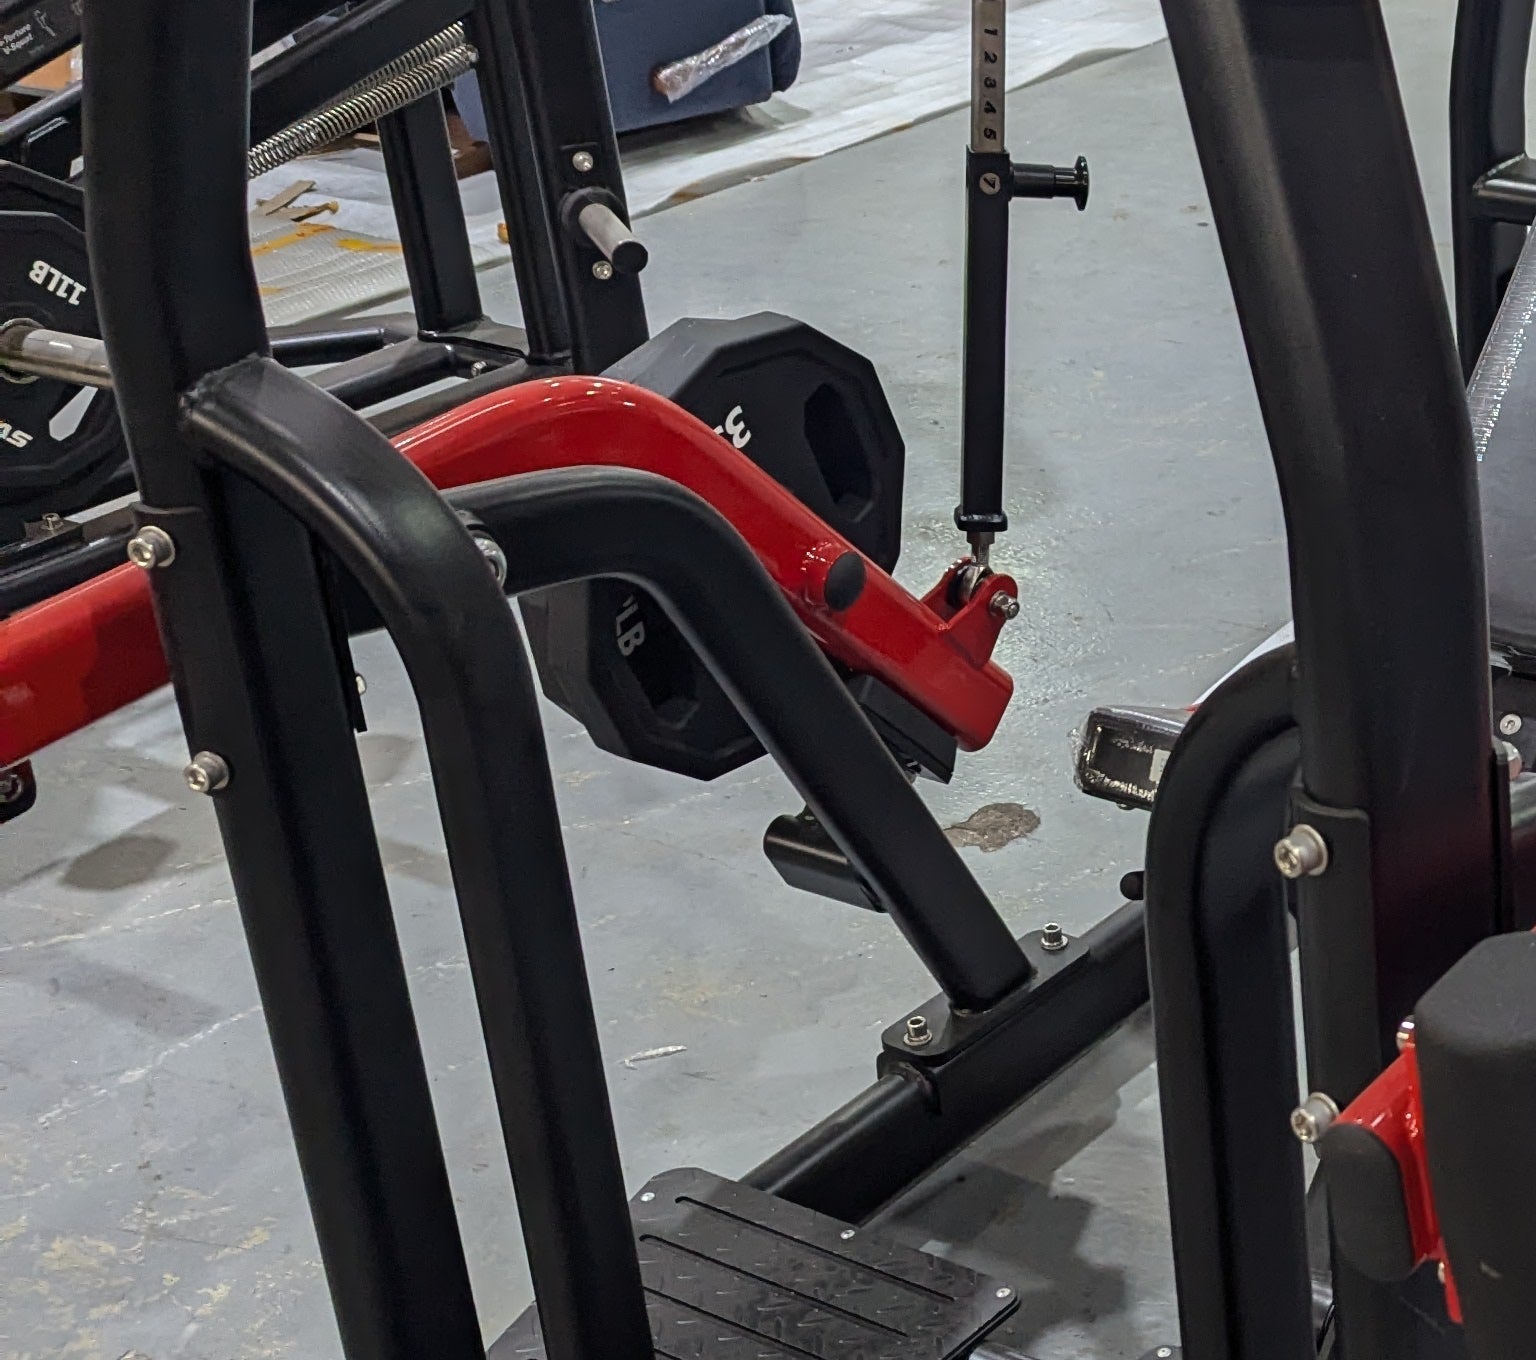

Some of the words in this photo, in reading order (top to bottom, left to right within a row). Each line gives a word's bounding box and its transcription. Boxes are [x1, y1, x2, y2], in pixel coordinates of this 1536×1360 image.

[984, 51, 998, 64] 2
[984, 76, 997, 89] 3
[984, 127, 997, 141] 5
[29, 260, 87, 306] 11LB
